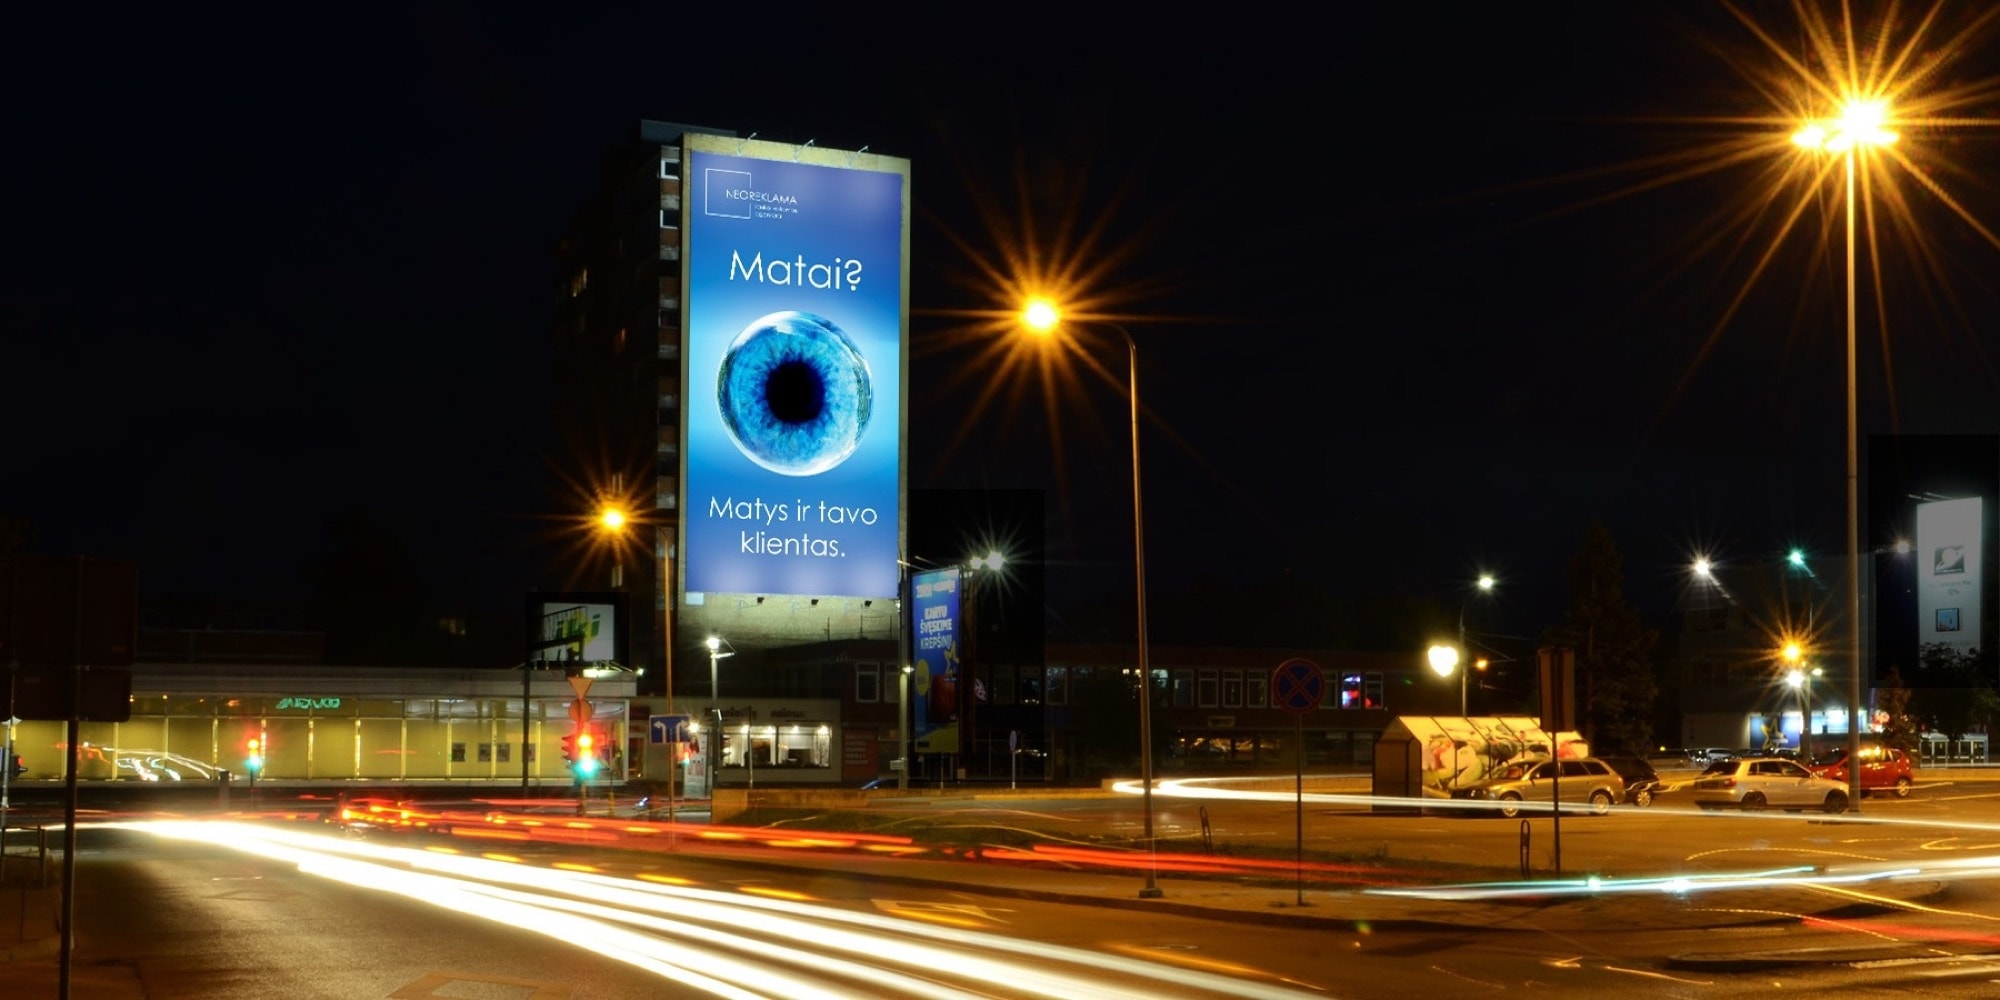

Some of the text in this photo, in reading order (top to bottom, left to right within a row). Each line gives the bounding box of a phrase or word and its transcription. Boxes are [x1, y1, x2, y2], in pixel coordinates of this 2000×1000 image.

[726, 189, 798, 204] NEOREKLAMA
[729, 249, 863, 292] Matai?
[709, 496, 878, 526] Matys ir tavo
[741, 530, 846, 558] klientas.
